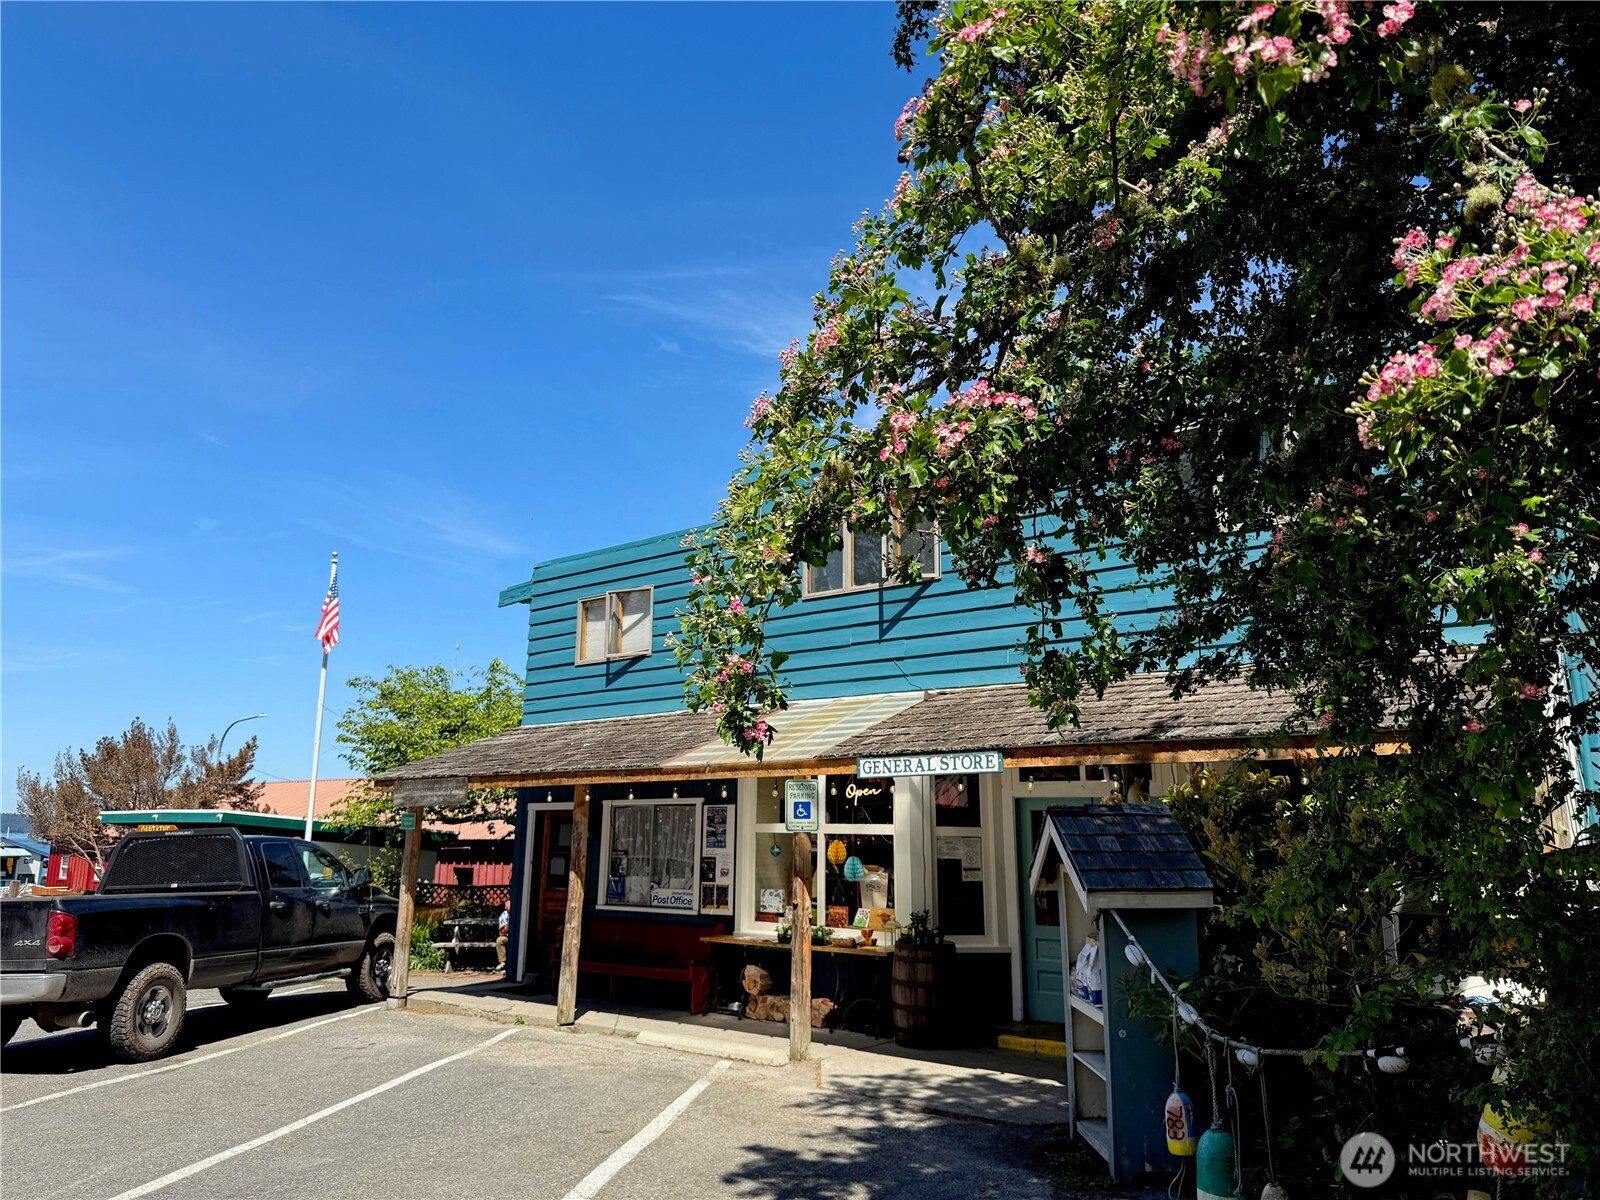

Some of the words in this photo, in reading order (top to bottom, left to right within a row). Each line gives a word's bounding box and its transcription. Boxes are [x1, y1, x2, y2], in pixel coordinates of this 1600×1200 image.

[862, 757, 936, 774] GENERAL
[940, 754, 996, 771] STORE
[789, 783, 817, 791] RESERVED
[790, 792, 816, 800] PARKING
[845, 783, 882, 806] Open
[652, 894, 670, 905] Post
[670, 895, 693, 906] Office
